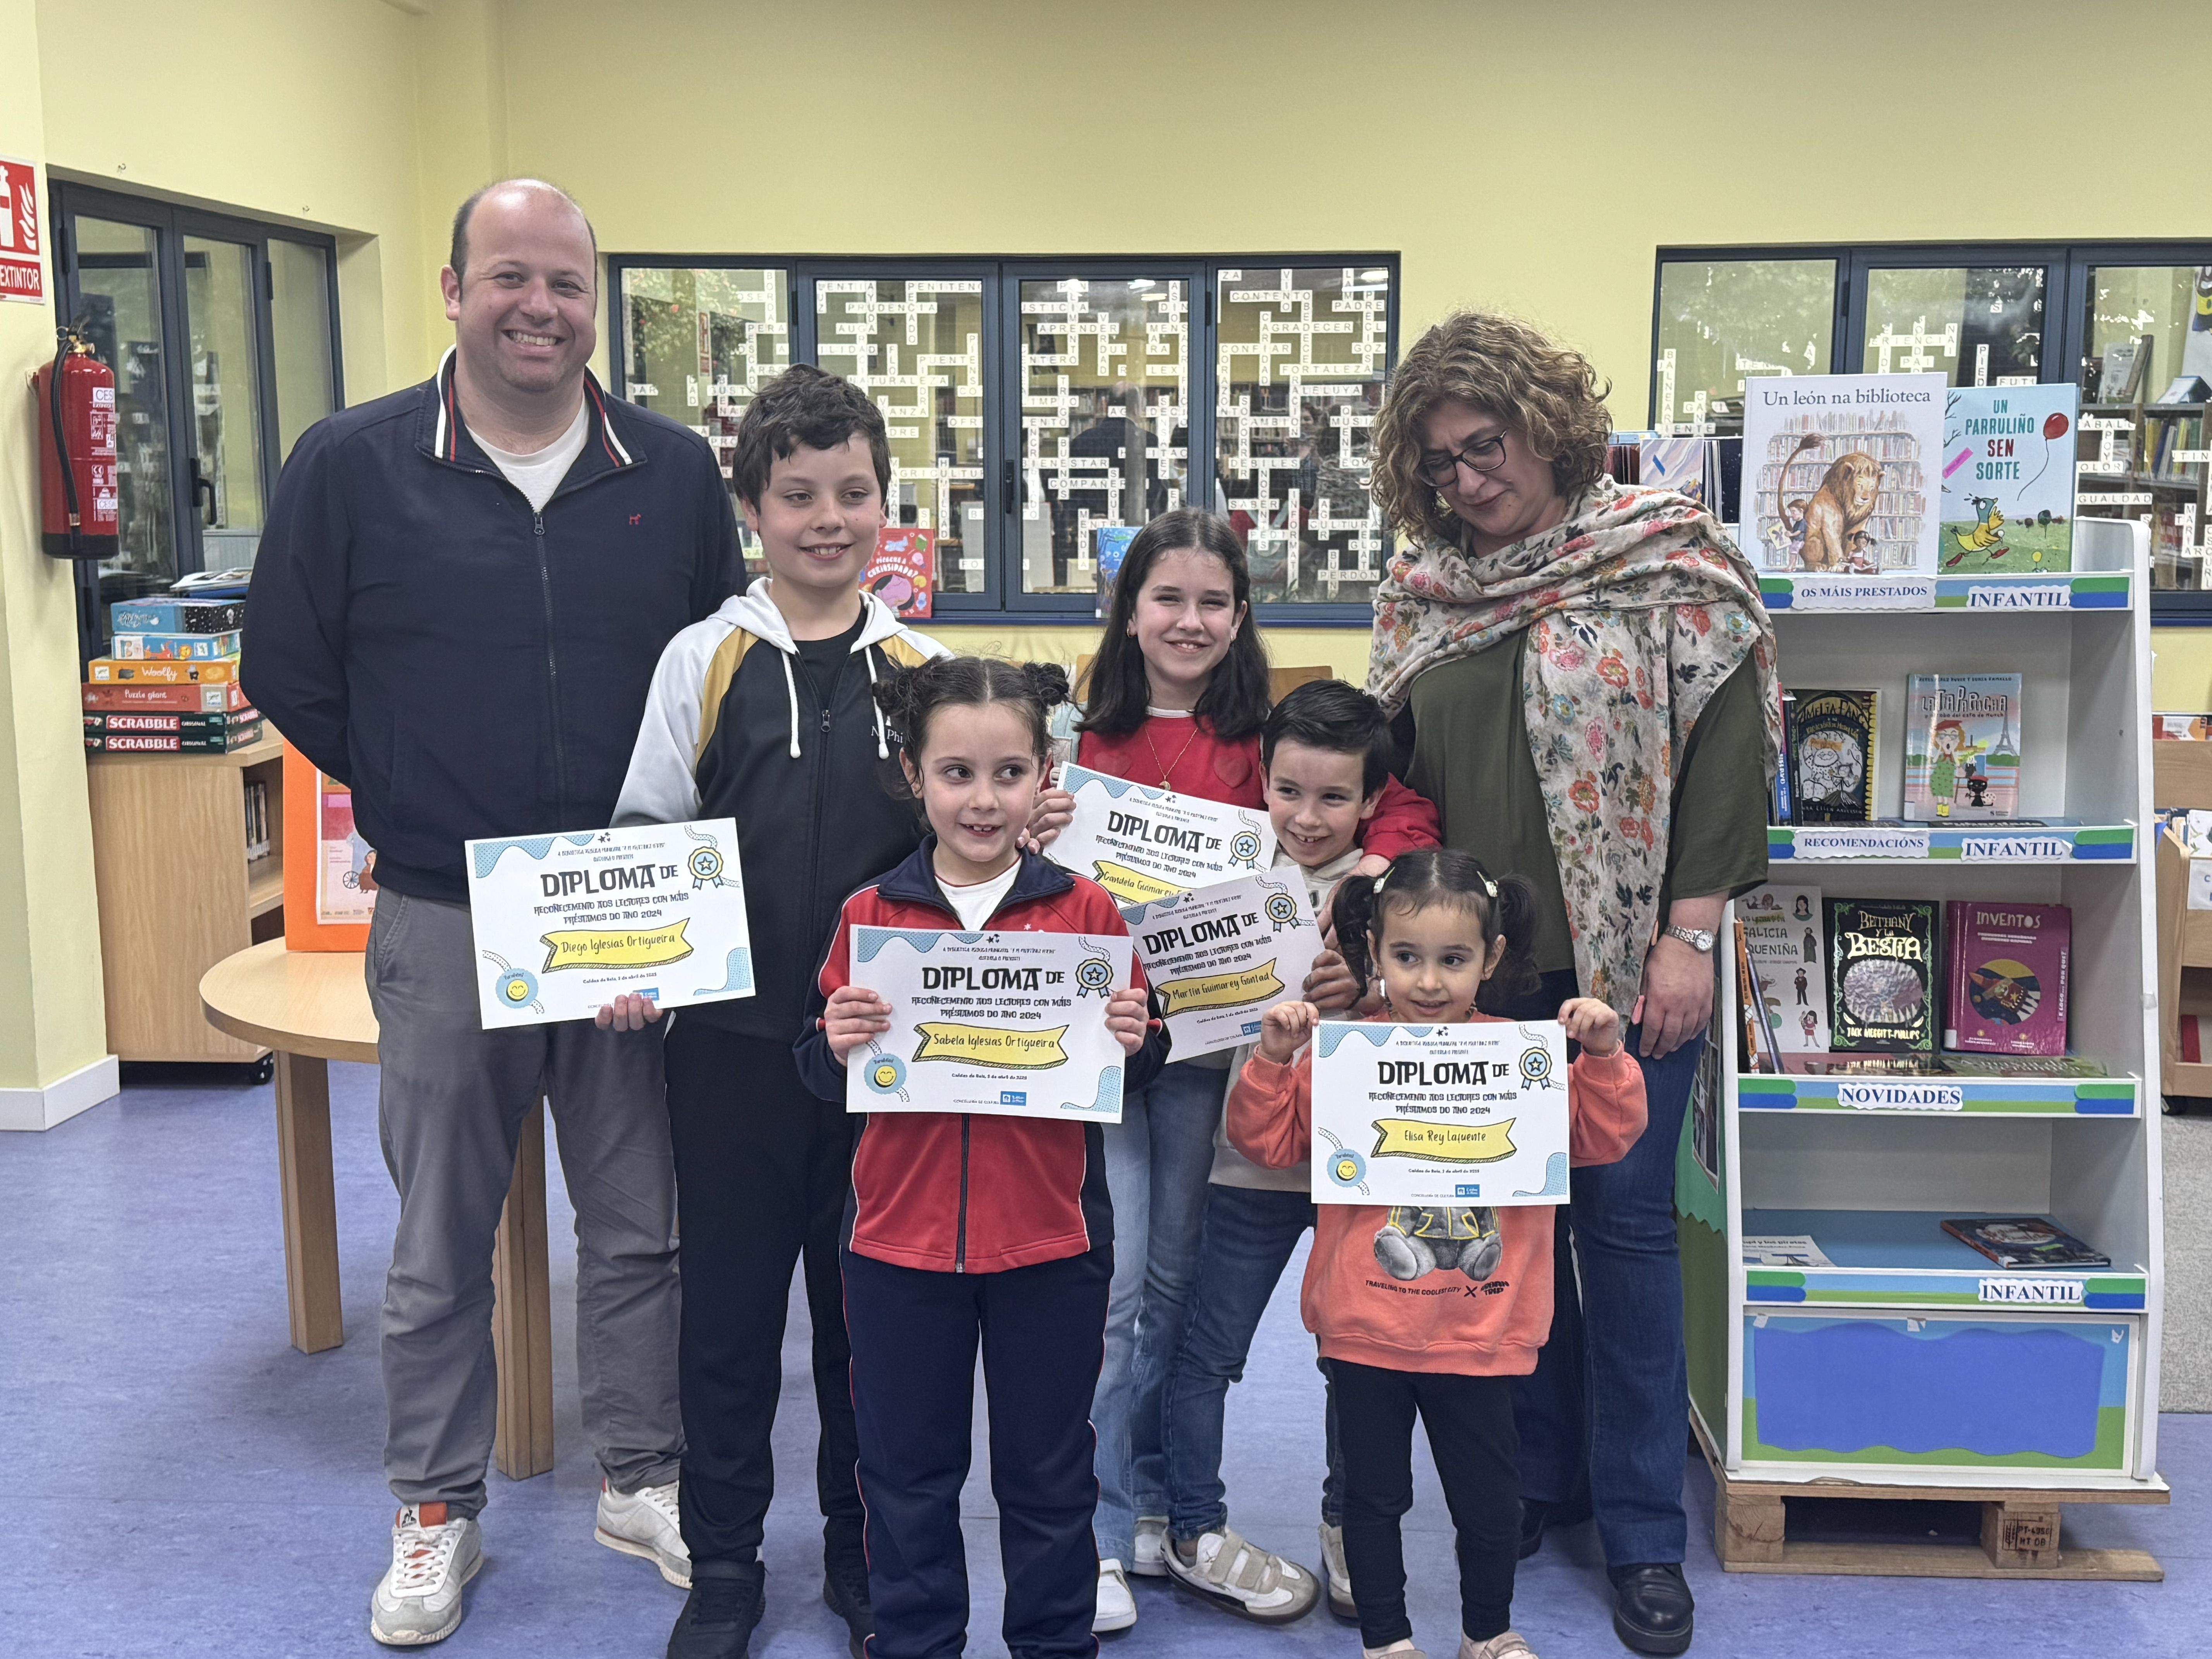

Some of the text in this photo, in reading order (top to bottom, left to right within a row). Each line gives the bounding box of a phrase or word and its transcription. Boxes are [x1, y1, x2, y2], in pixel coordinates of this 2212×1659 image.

[0, 266, 40, 289] EXTINTOR
[1763, 389, 1930, 406] Un león na biblioteca
[1994, 400, 2008, 414] UN
[1965, 414, 2034, 435] PARRULIÑO
[1987, 439, 2014, 457] SEN
[1976, 461, 2020, 480] SORTE
[2186, 506, 2194, 555] MARIA
[1801, 586, 1927, 598] OS MÁIS PRESTADOS
[1970, 592, 2068, 607] INFANTIL
[142, 666, 177, 681] Woolfy
[125, 689, 145, 698] Puzzle
[109, 718, 177, 729] SCRABBLE
[109, 738, 177, 749] SCRABBLE
[1108, 811, 1204, 853] DIPLOMA
[1206, 837, 1222, 850] DE
[1804, 836, 1924, 848] RECOMENDACIÓNS
[1966, 842, 2062, 856] INFANTIL
[541, 864, 678, 897] DIPLOMA DE
[1104, 871, 1134, 888] Candela
[641, 909, 662, 918] 2024
[1858, 911, 1915, 933] BETHANY
[1977, 912, 2041, 929] INVENTOS
[1142, 914, 1240, 955] DIPLOMA
[1241, 912, 1259, 926] DE
[561, 934, 675, 956] Diego Iglesias Ortigueira
[1844, 932, 1923, 962] BESTIA
[922, 967, 1065, 990] DIPLOMA DE
[934, 1034, 1054, 1051] Sabela Iglesias Ortigueira
[1378, 1061, 1509, 1085] DIPLOMA DE
[1841, 1088, 1960, 1104] NOVIDADES
[1405, 1130, 1486, 1145] Elisa Rey Lafuente
[1365, 1280, 1397, 1291] TRAVELING
[1982, 1284, 2080, 1300] INFANTIL
